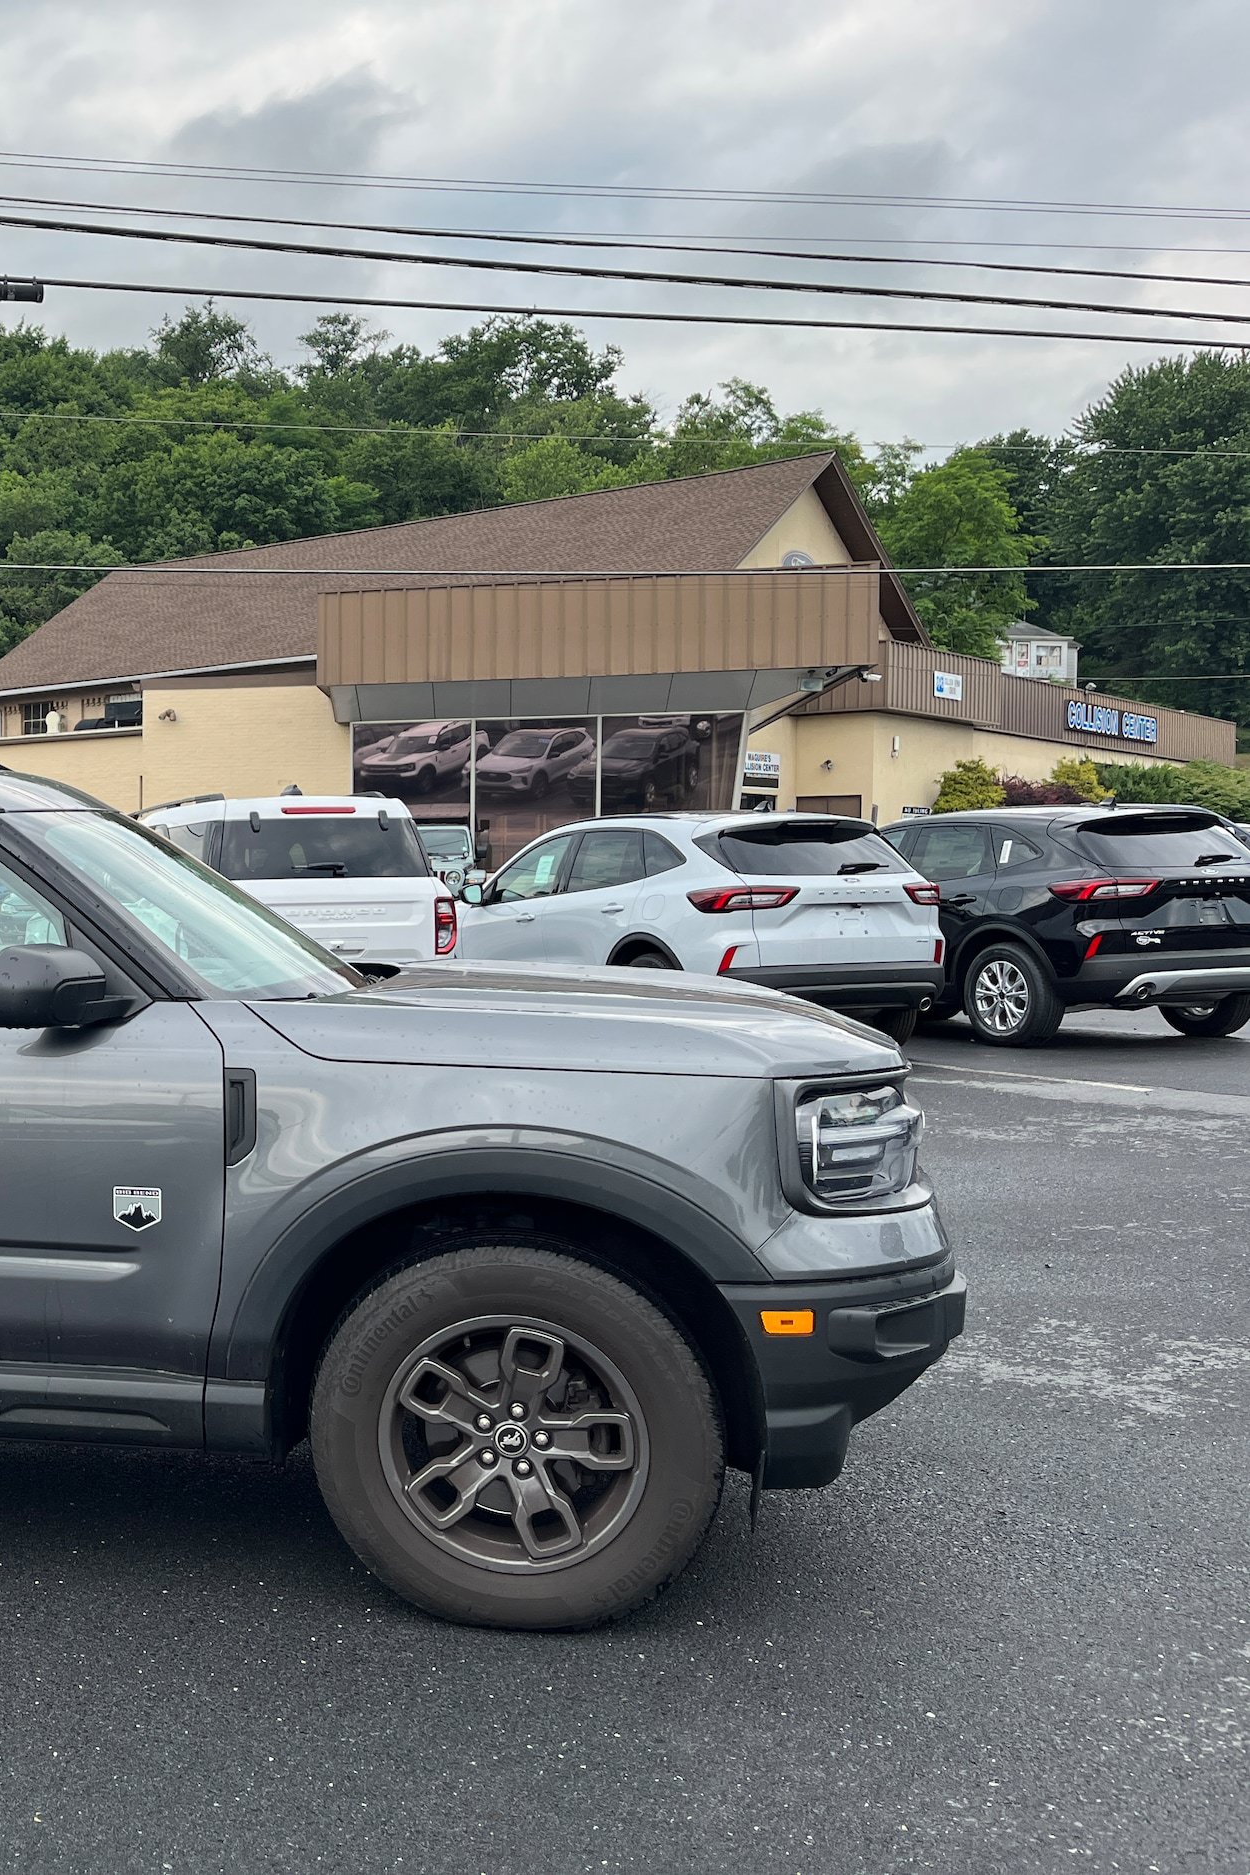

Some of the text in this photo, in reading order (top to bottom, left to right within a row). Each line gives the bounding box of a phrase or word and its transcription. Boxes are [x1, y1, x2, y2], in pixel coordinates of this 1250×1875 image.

[1068, 701, 1157, 742] COLLISION CENTER
[745, 762, 779, 772] LLISION CENTER
[340, 1300, 421, 1398] Continental
